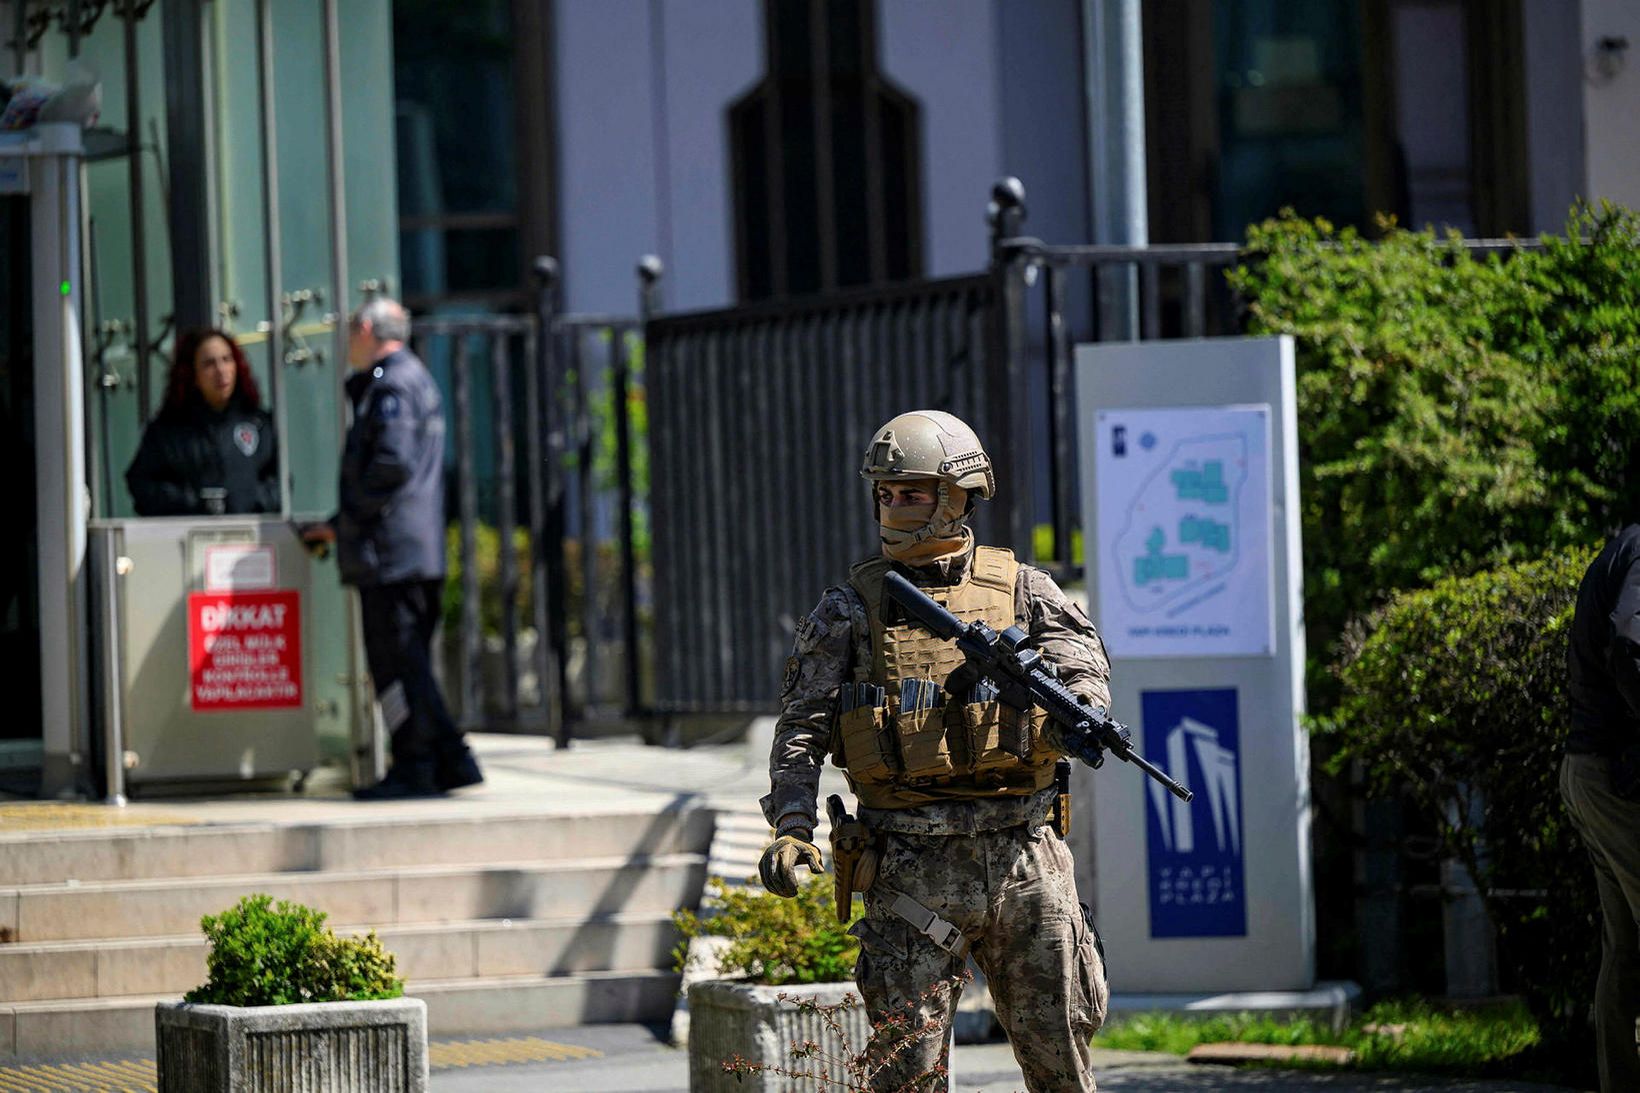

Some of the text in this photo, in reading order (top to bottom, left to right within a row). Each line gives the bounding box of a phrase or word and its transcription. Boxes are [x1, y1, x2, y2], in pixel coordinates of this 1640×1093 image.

[201, 600, 287, 631] DİKKAT
[1160, 865, 1231, 878] YAPI
[1160, 890, 1234, 904] PLAZA
